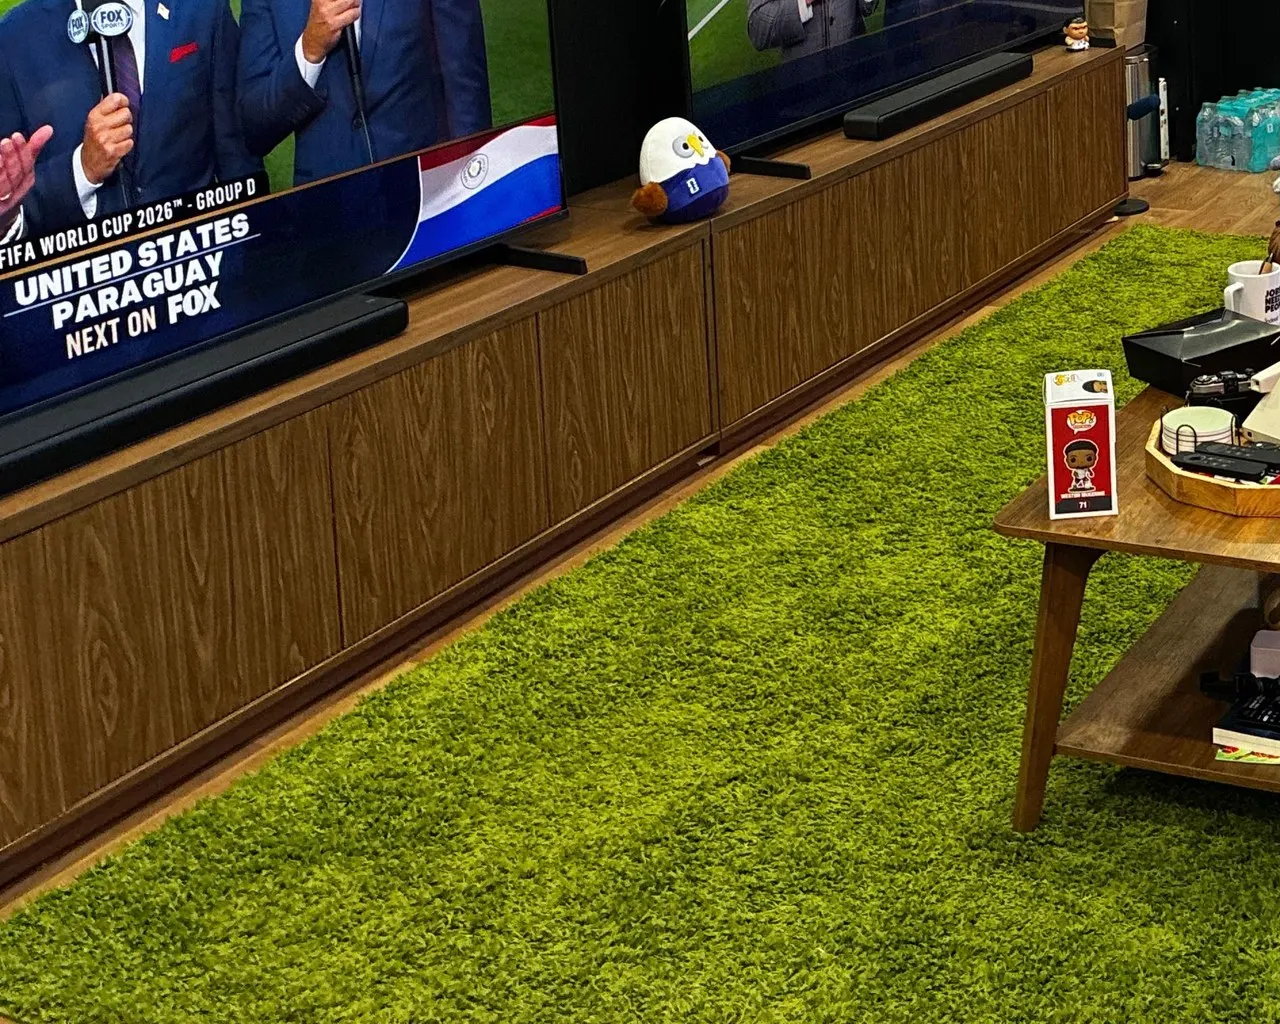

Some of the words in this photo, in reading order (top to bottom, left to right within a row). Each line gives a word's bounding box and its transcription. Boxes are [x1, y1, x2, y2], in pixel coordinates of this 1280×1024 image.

[72, 16, 84, 30] FOX
[100, 10, 123, 23] FOX
[0, 242, 36, 270] FIFA
[40, 223, 98, 256] WORLD
[102, 213, 133, 238] CUP
[195, 184, 243, 211] GROUP
[246, 178, 256, 196] D
[14, 250, 133, 307] UNITED
[138, 213, 250, 268] STATES
[52, 251, 224, 330] PARAGUAY
[66, 317, 120, 360] NEXT
[128, 306, 157, 338] ON
[167, 281, 221, 325] FOX
[1067, 410, 1096, 424] POP!
[1078, 501, 1087, 509] 71
